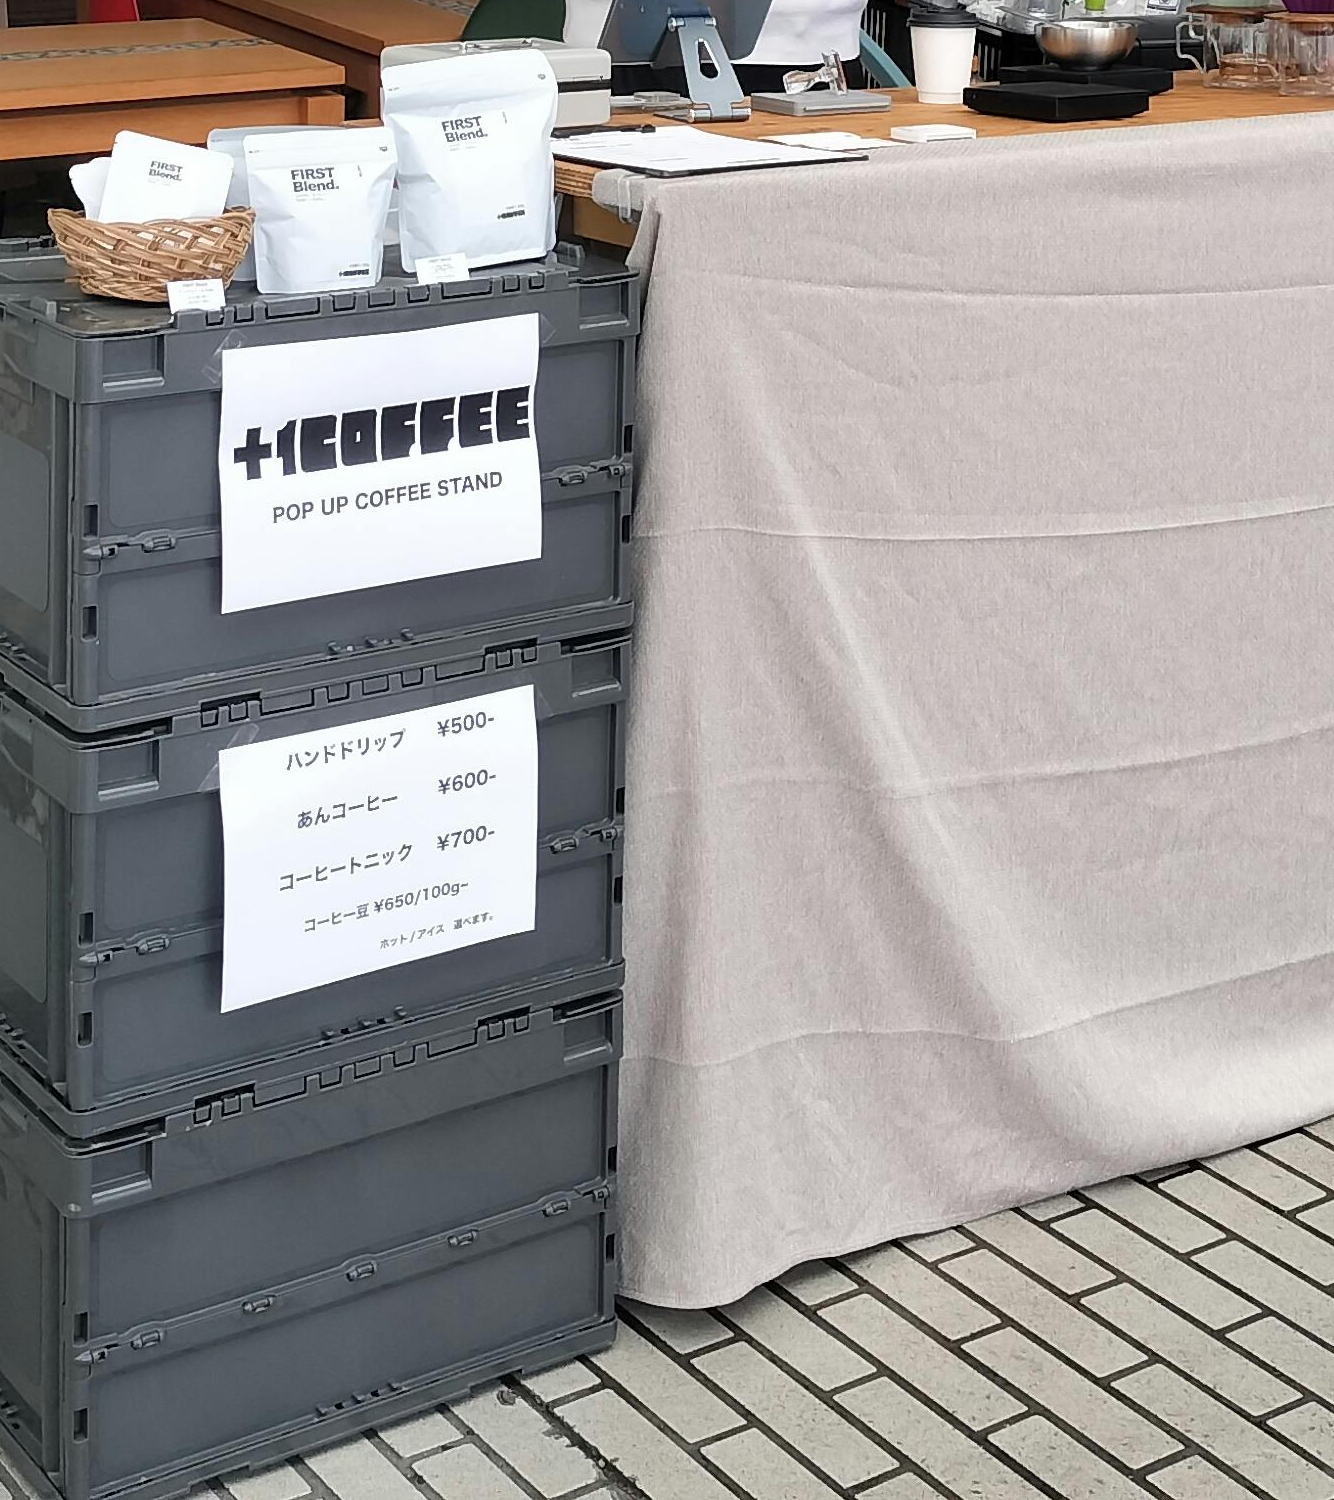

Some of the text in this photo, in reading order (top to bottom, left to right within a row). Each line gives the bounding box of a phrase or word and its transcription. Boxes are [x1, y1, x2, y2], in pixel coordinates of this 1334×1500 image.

[440, 116, 482, 132] FIRST
[444, 127, 488, 143] Blend.
[150, 160, 184, 173] FIRST
[290, 167, 335, 181] FIRST
[148, 168, 182, 182] Blend.
[292, 177, 340, 193] Blend.
[271, 470, 504, 524] POP UP COFFEE STAND
[286, 712, 496, 771] ハンドドリップ ¥500-
[297, 769, 497, 829] あんコーヒー ¥600-
[279, 825, 496, 892] コーヒートニック ¥700-
[304, 904, 370, 933] コーヒー豆
